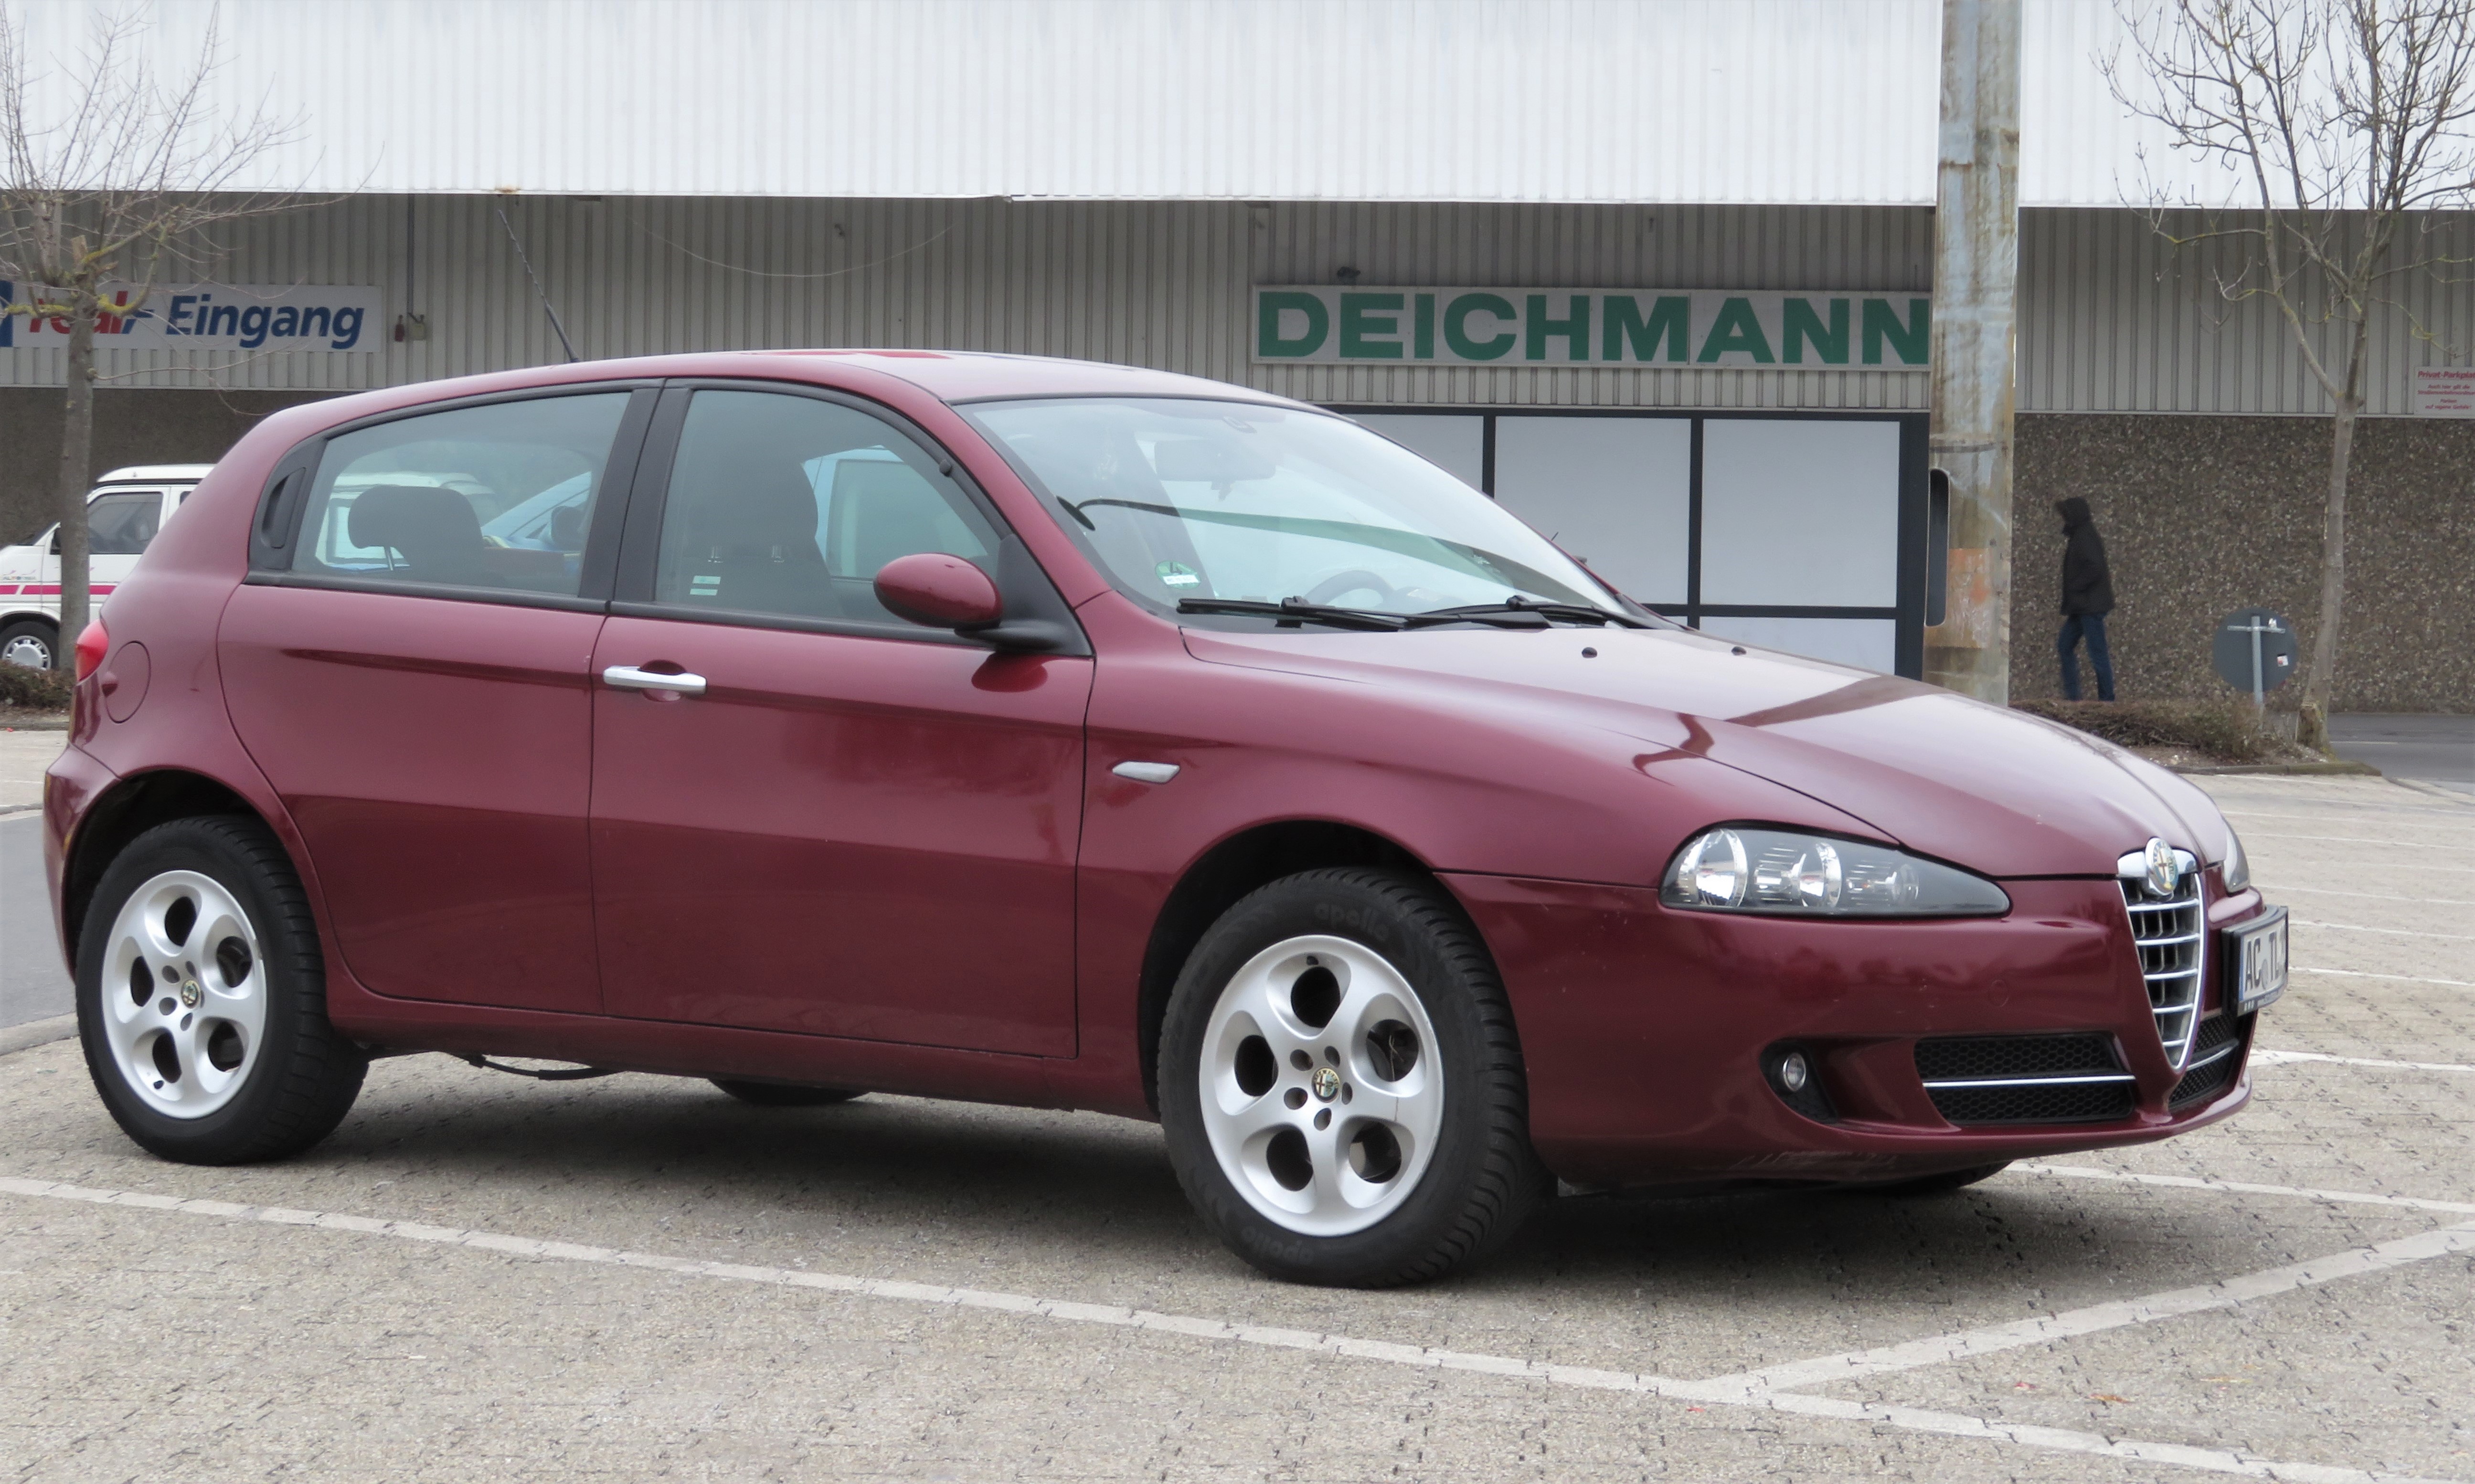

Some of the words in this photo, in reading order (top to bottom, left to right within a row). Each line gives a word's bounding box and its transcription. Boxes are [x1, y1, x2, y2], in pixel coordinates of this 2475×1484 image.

[167, 294, 364, 349] Eingang
[1259, 292, 1929, 364] DEICHMANN
[2245, 937, 2261, 992] AC
